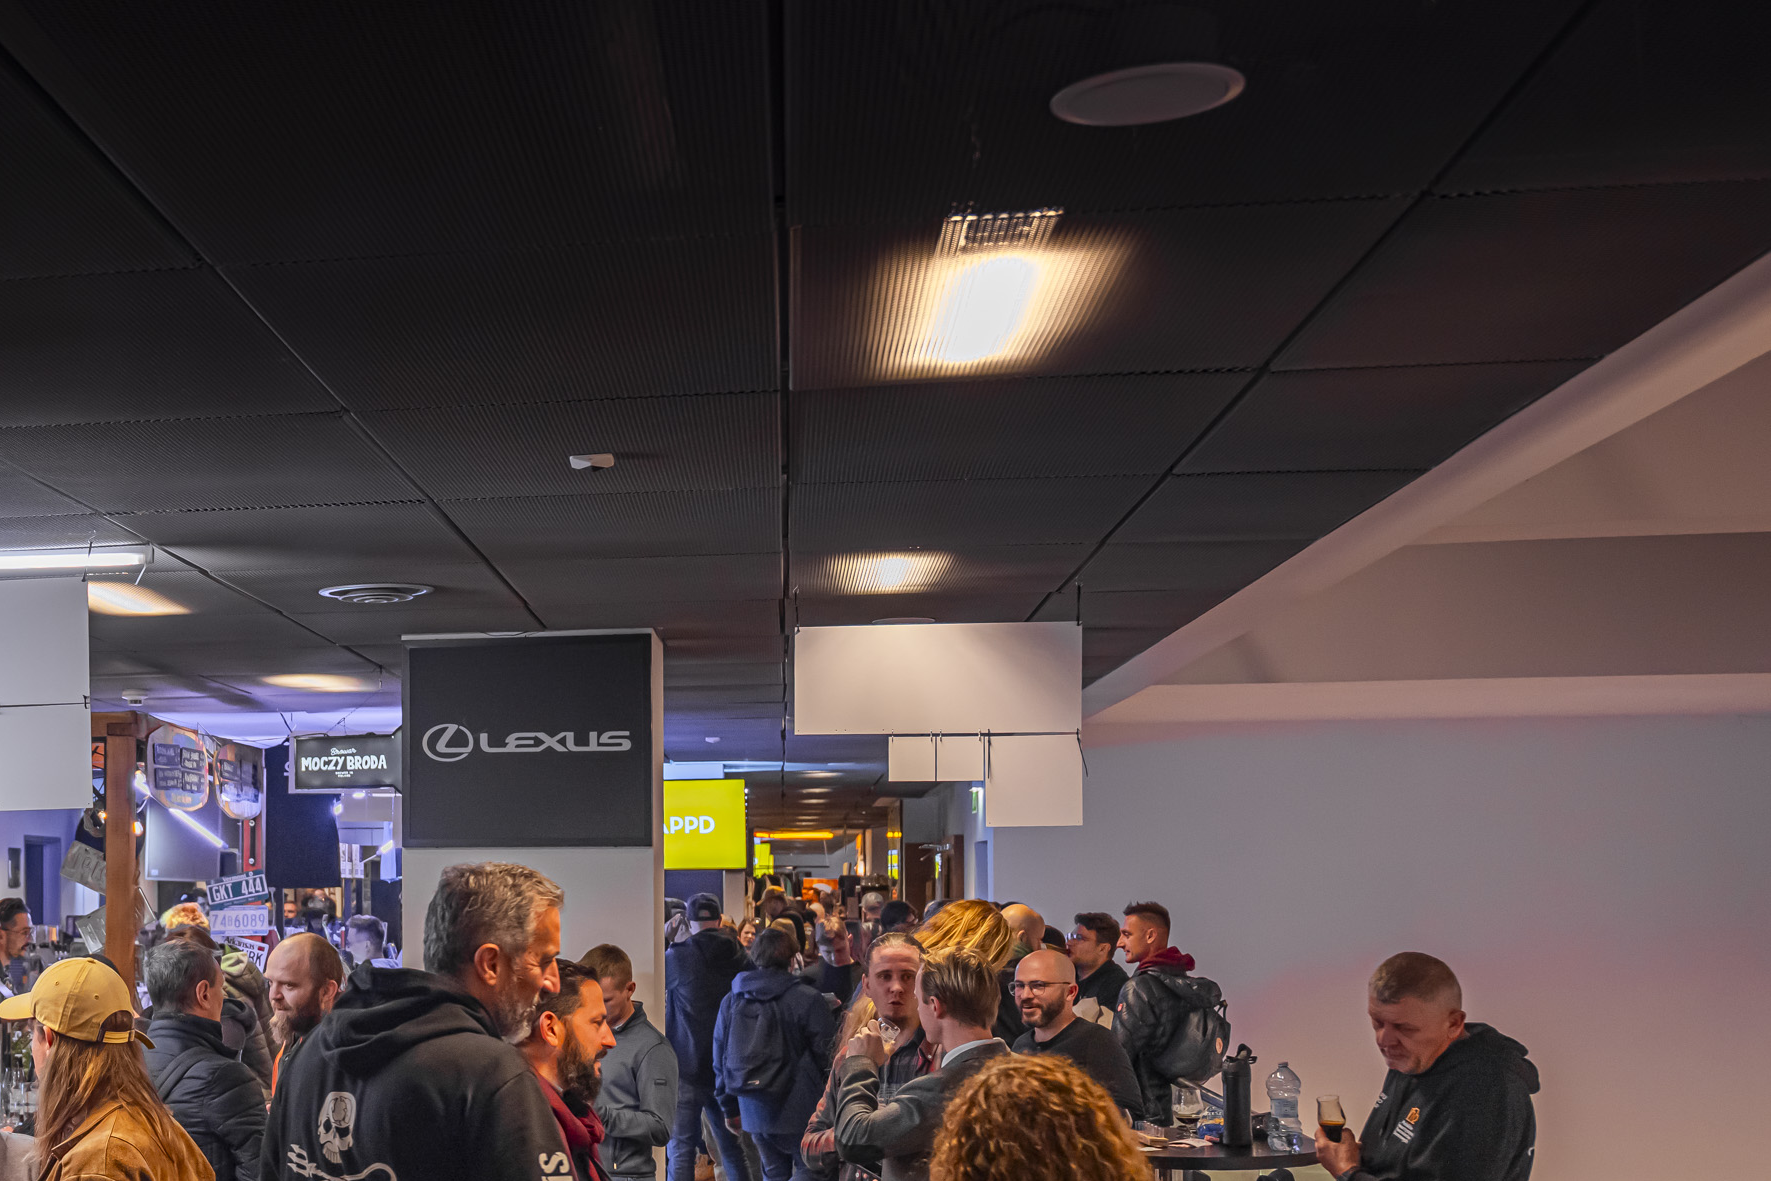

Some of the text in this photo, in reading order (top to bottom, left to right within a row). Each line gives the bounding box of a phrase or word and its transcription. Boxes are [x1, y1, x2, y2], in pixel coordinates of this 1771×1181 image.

[480, 730, 632, 753] LEXUS
[300, 754, 388, 772] MOCZY BRODA
[222, 873, 246, 882] Vermont
[212, 883, 234, 901] GKT
[241, 877, 263, 895] 444
[224, 935, 255, 950] Arkansas
